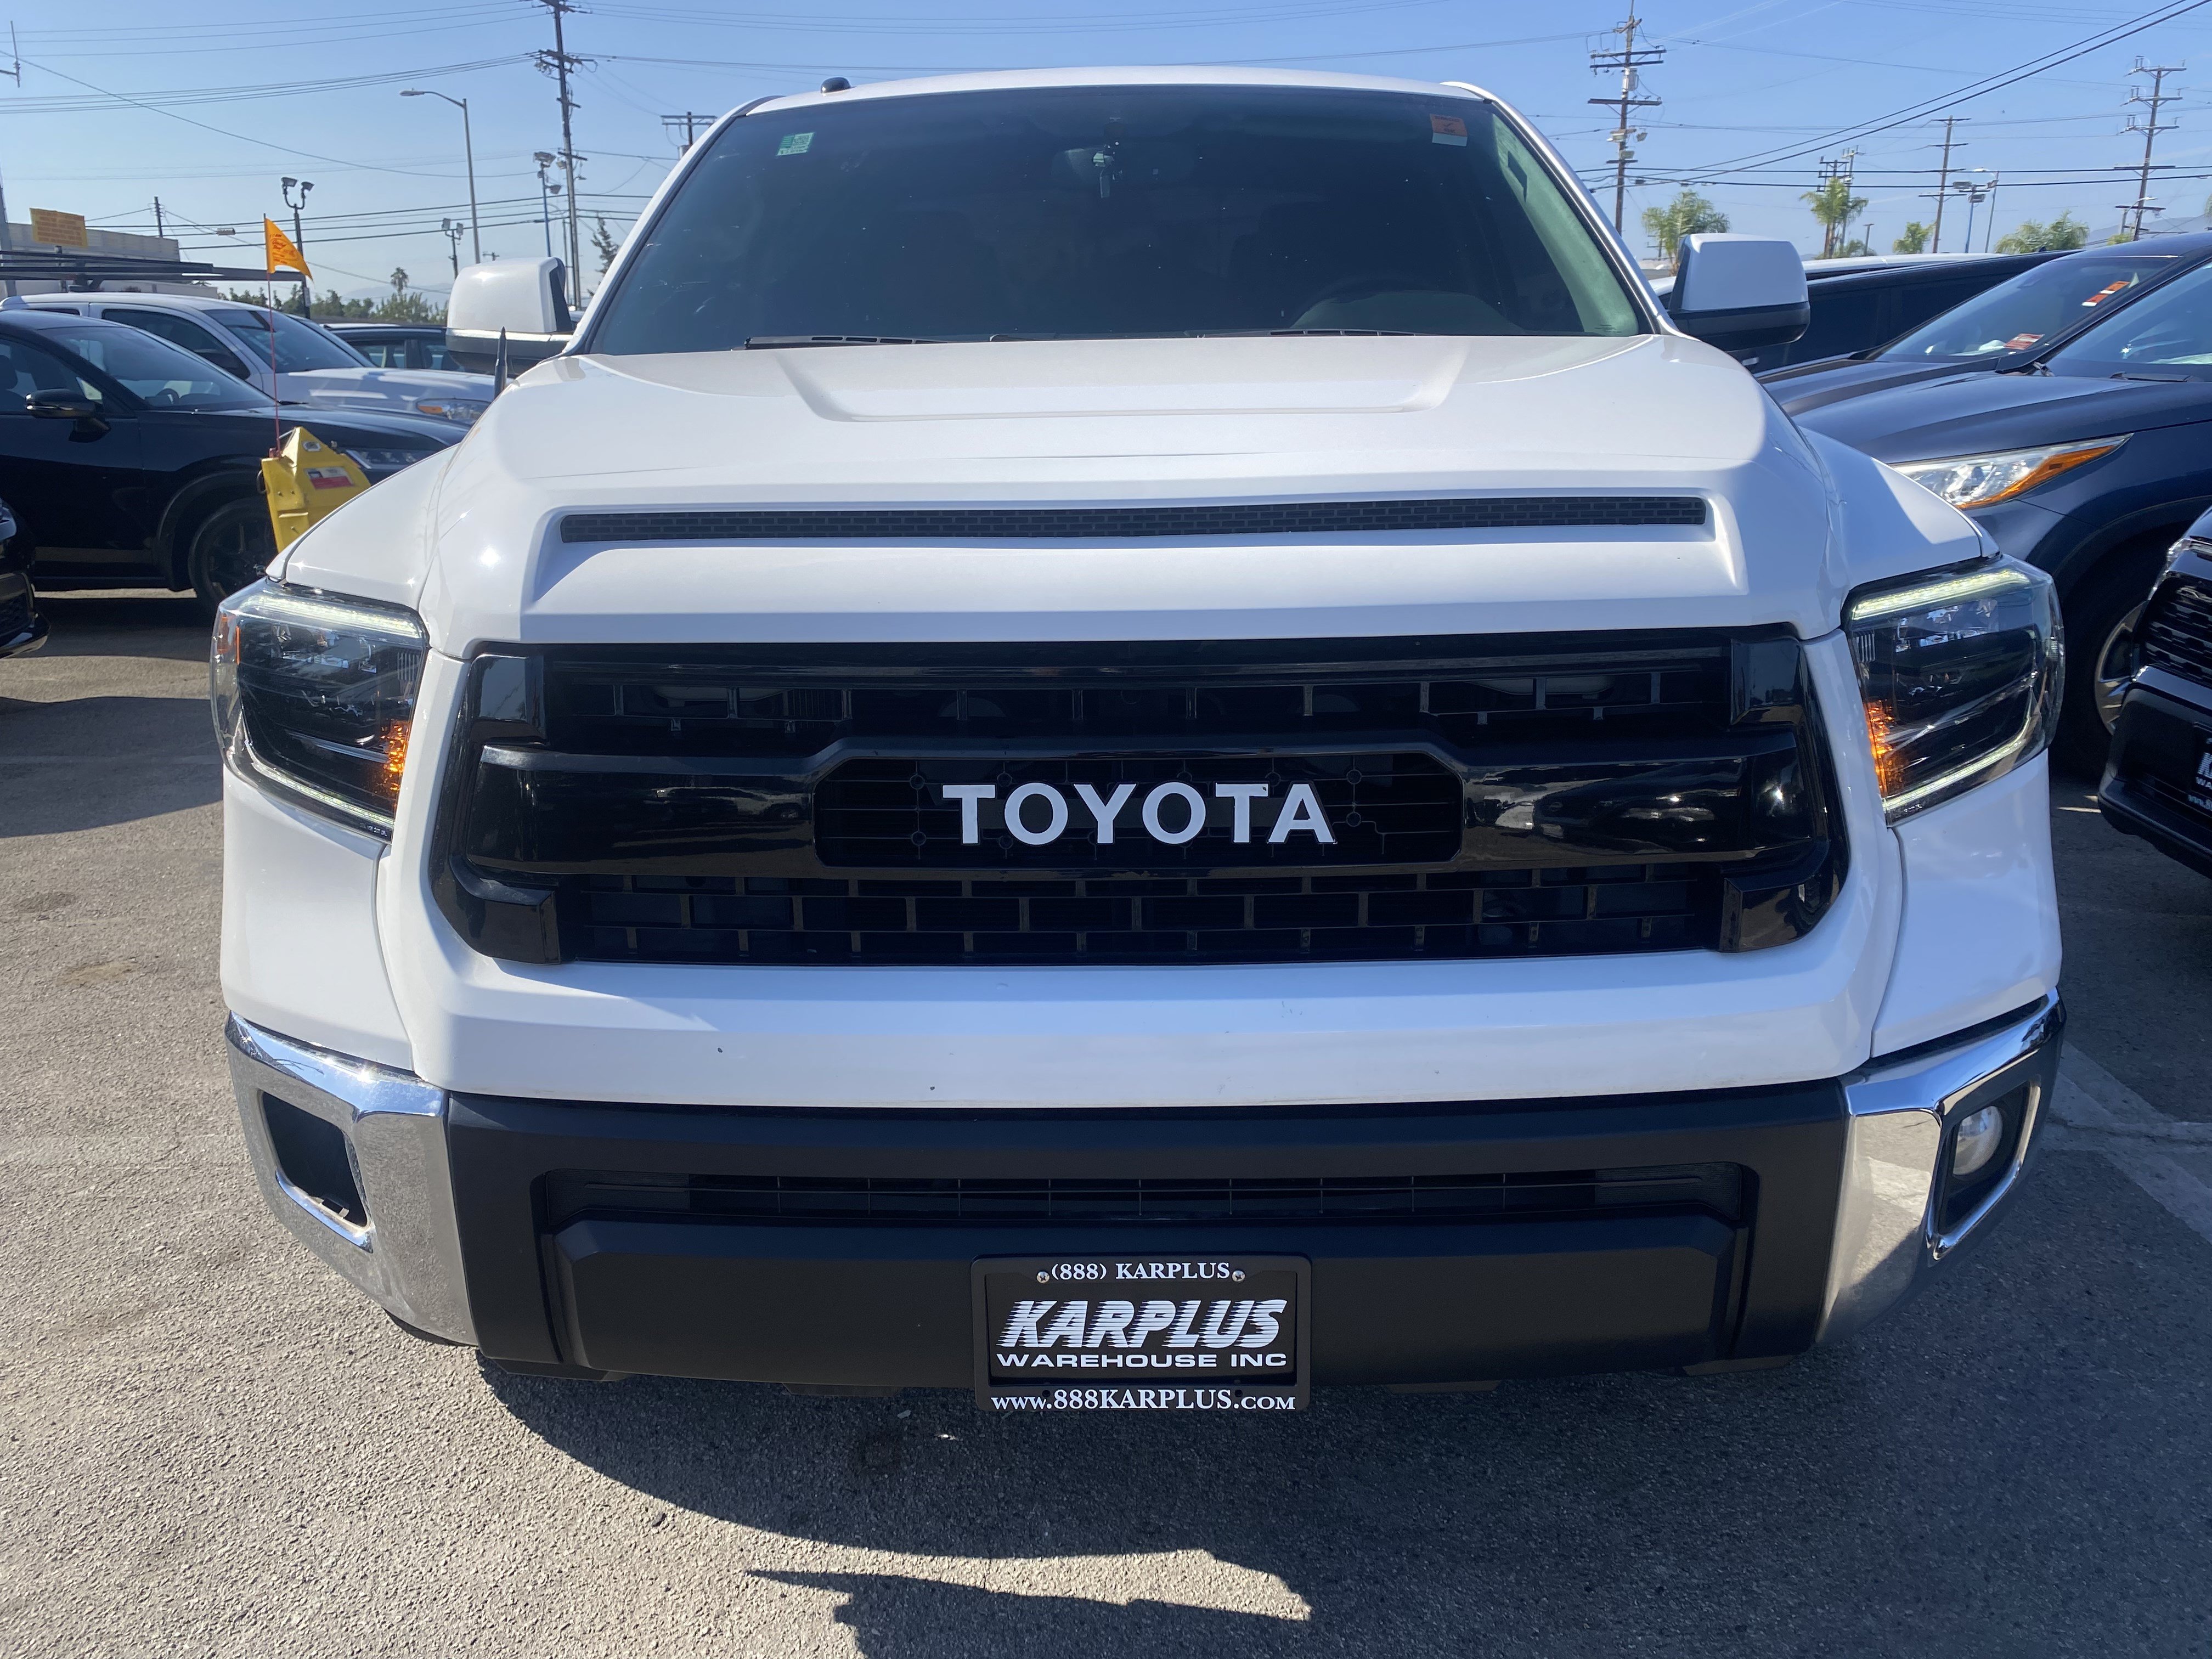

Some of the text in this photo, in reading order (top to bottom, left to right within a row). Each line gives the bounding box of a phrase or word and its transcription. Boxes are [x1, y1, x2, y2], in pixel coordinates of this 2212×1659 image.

[943, 782, 1338, 845] TOYOTA
[1051, 1262, 1230, 1280] (888) KARPLUS
[996, 1299, 1288, 1348] KARPLUS
[997, 1353, 1286, 1368] WAREHOUSE INC
